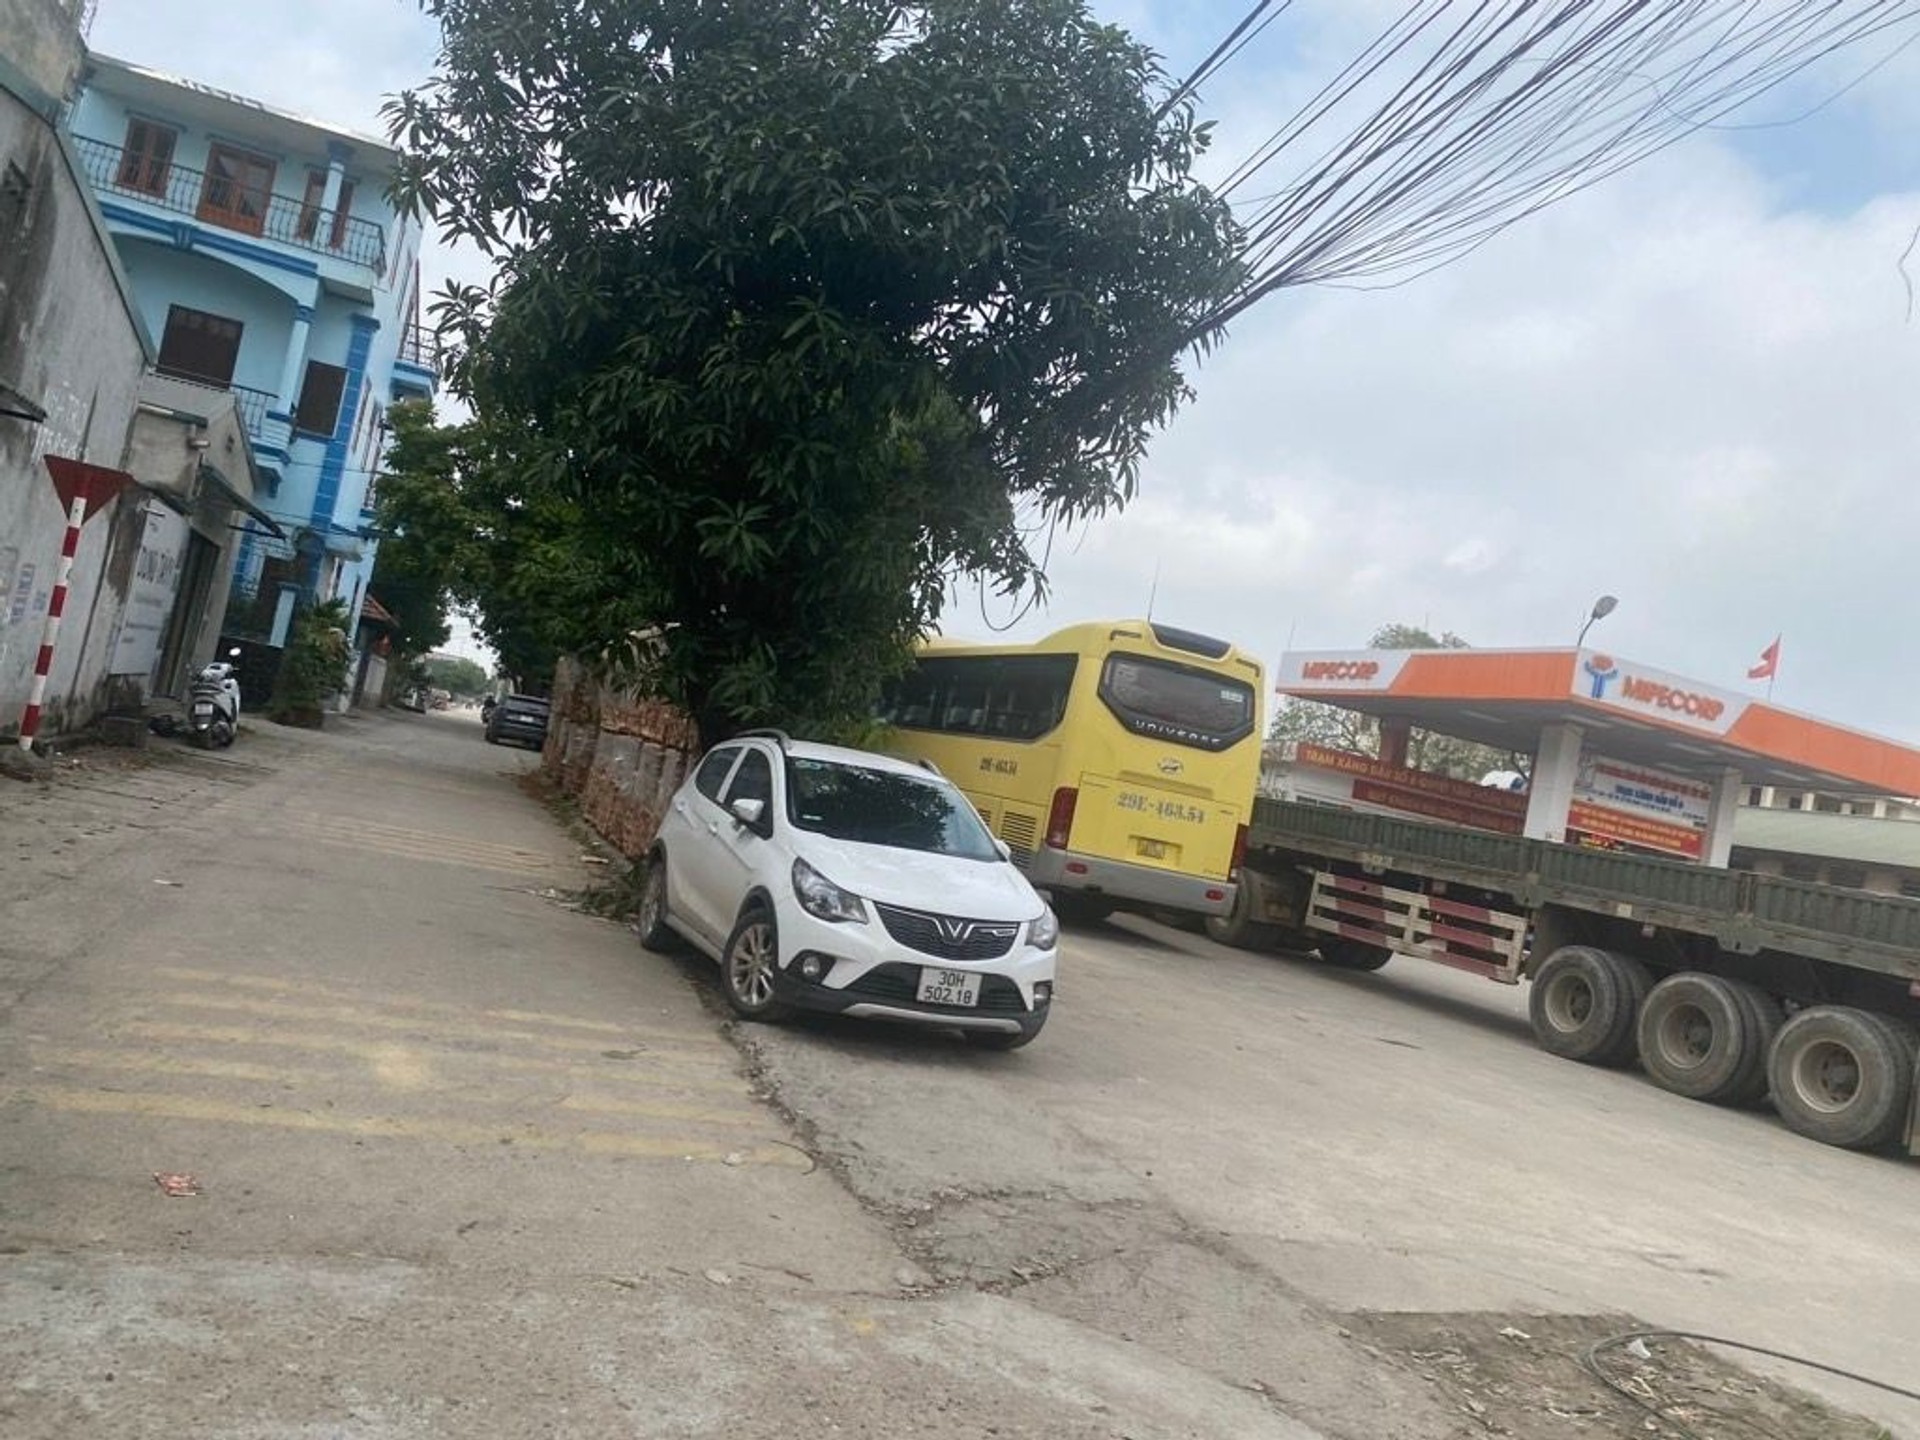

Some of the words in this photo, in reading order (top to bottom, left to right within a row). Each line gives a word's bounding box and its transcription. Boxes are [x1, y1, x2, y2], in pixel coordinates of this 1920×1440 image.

[1303, 661, 1379, 679] MIPECORP
[1621, 675, 1724, 721] MIPECORP
[1135, 719, 1221, 745] UNIVERSE
[938, 971, 965, 987] 30H
[924, 985, 972, 1005] 502.18
